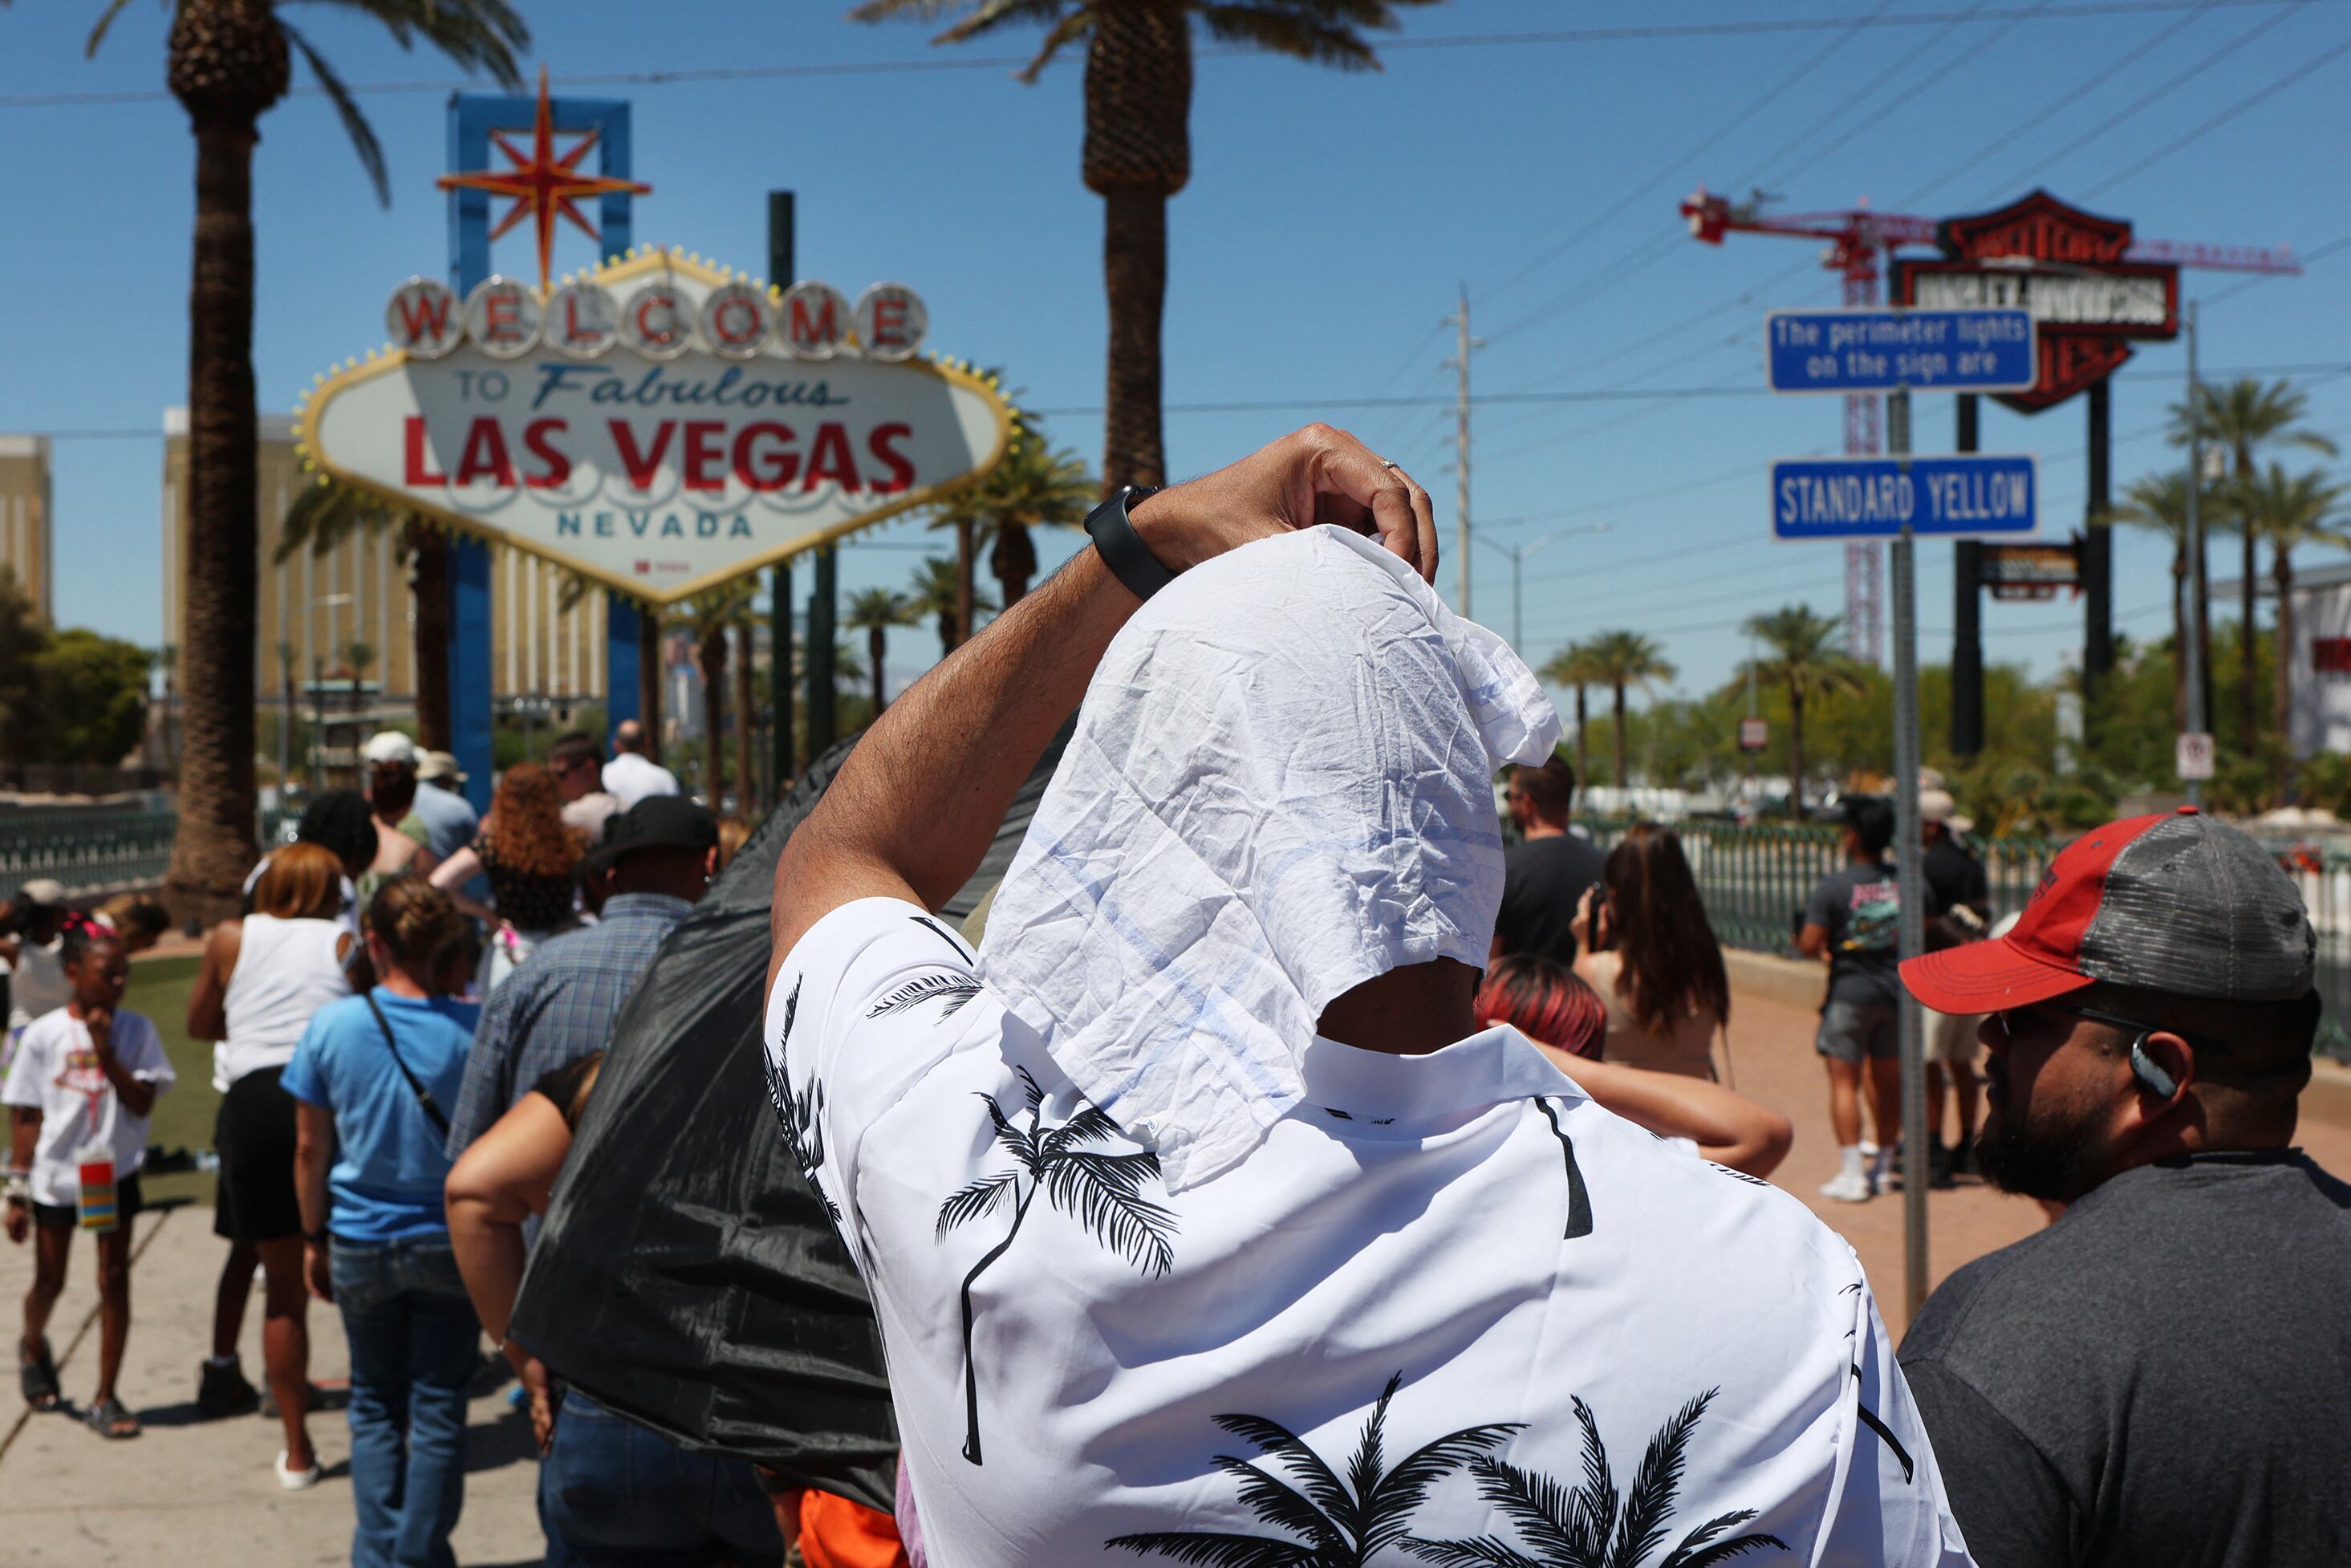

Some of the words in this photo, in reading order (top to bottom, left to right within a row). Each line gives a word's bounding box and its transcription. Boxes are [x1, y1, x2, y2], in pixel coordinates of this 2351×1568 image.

[398, 294, 908, 345] WELCOME
[1776, 319, 1820, 346] The
[1829, 319, 1948, 354] perimeter
[1958, 315, 2027, 348] lights
[455, 369, 510, 401] TO
[530, 361, 849, 411] Fabulous
[1806, 356, 1838, 379] on
[1847, 351, 1888, 377] the
[1895, 347, 1948, 382] sign
[1956, 351, 1996, 376] are
[404, 416, 572, 489] LAS
[607, 417, 916, 495] VEGAS
[1780, 473, 1915, 524] STANDARD
[1926, 470, 2029, 520] YELLOW
[557, 511, 753, 538] NEVADA
